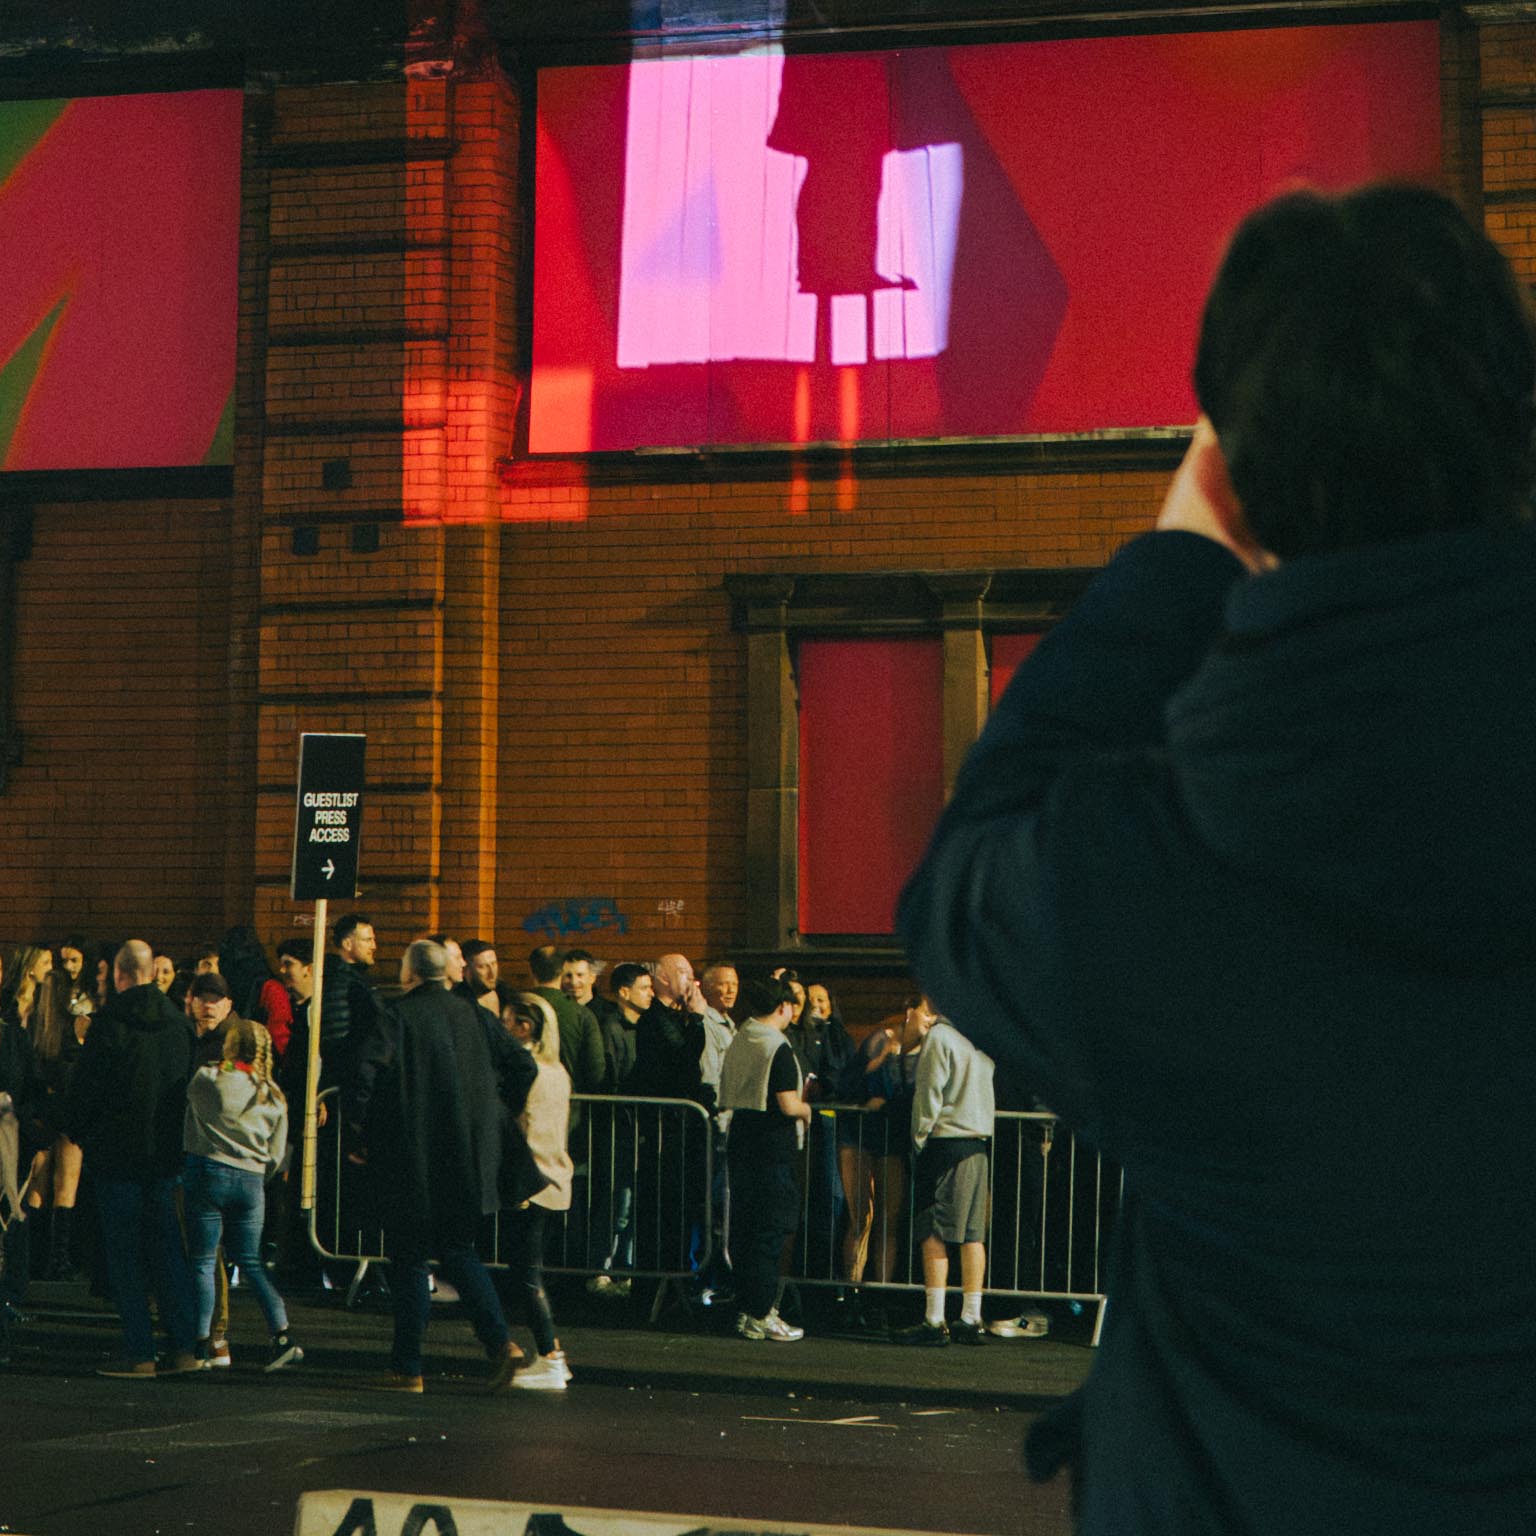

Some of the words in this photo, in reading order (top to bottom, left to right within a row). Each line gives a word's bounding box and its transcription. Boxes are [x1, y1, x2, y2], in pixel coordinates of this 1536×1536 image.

[303, 792, 359, 808] GUESTLIST
[314, 810, 347, 825] PRESS
[309, 827, 350, 842] ACCESS
